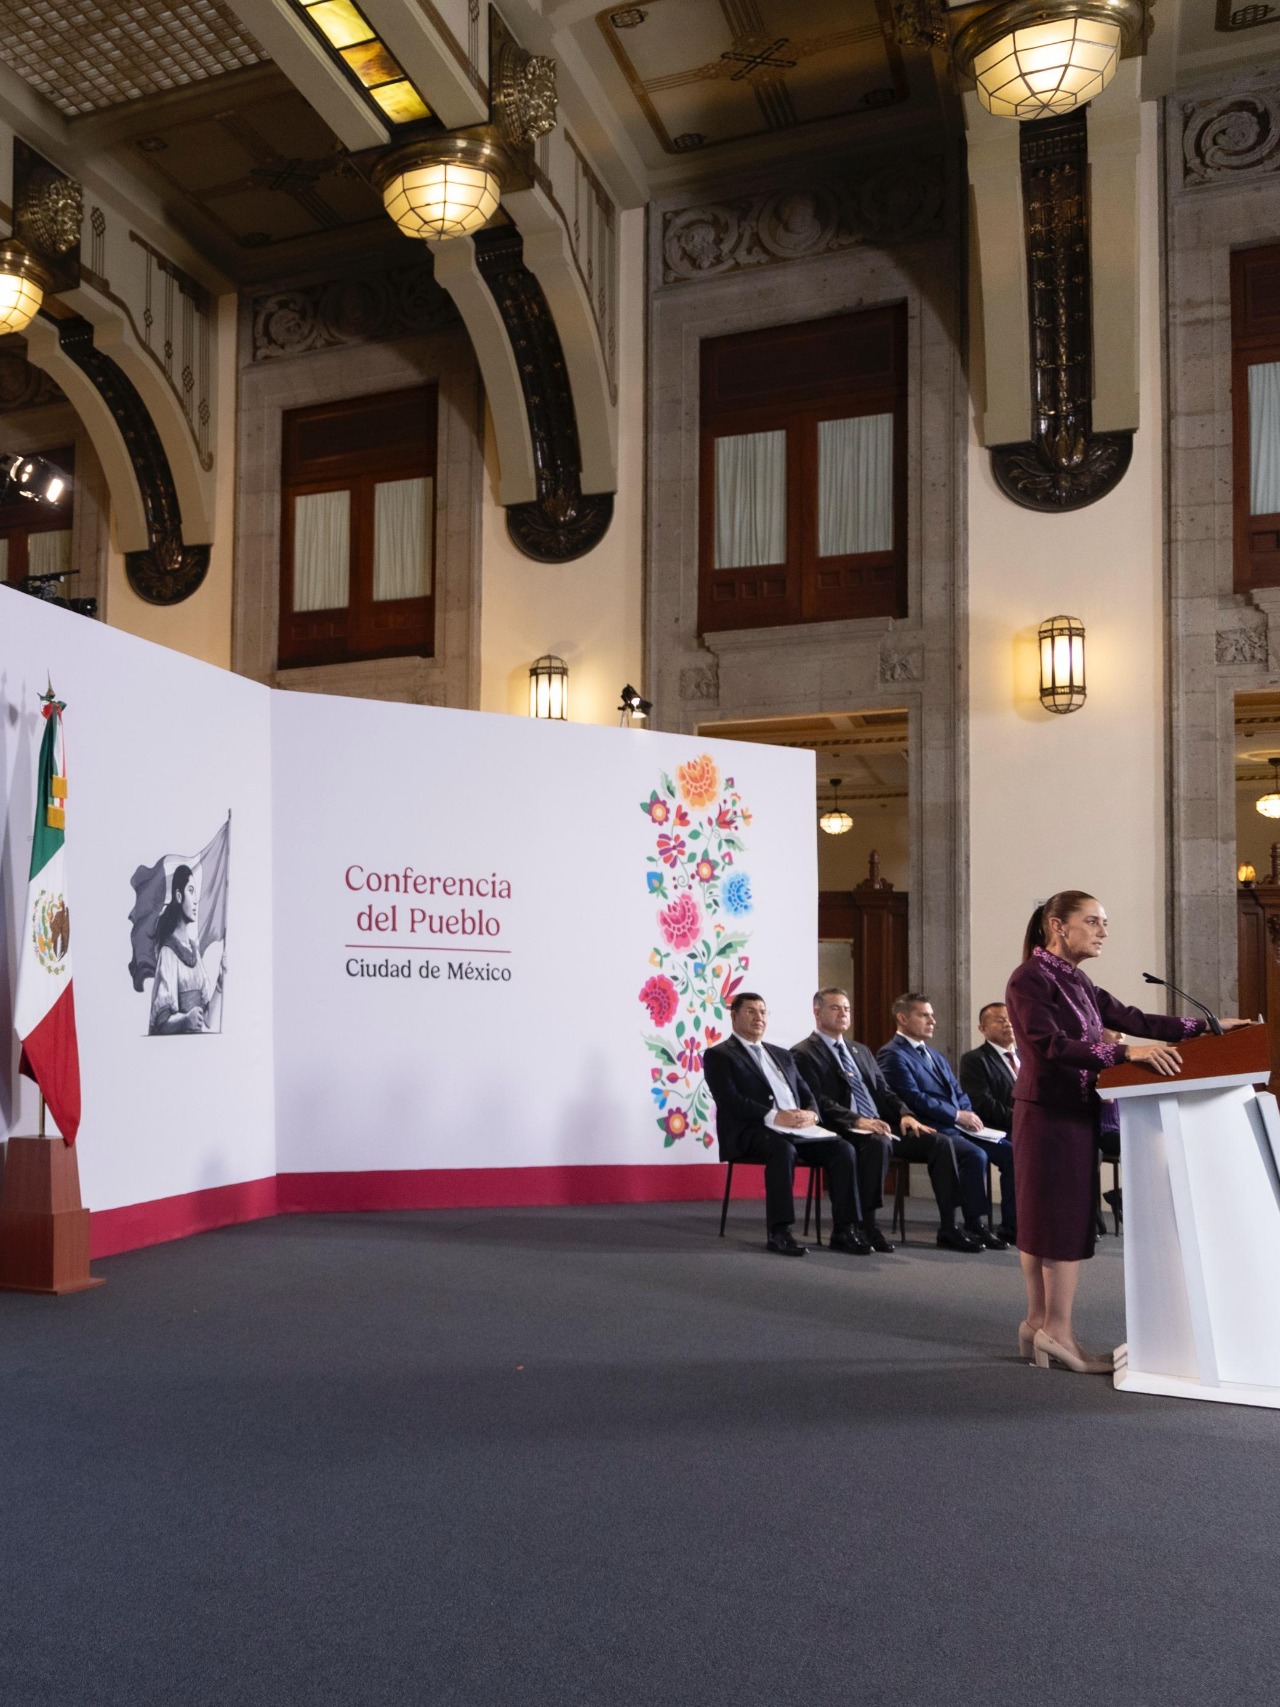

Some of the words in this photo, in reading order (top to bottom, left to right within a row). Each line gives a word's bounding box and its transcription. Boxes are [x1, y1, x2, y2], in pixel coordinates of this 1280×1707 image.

[345, 865, 511, 899] Conferencia
[357, 904, 398, 932] del
[409, 908, 500, 936] Pueblo
[346, 958, 411, 978] Ciudad
[419, 960, 440, 979] de
[448, 961, 511, 981] México
